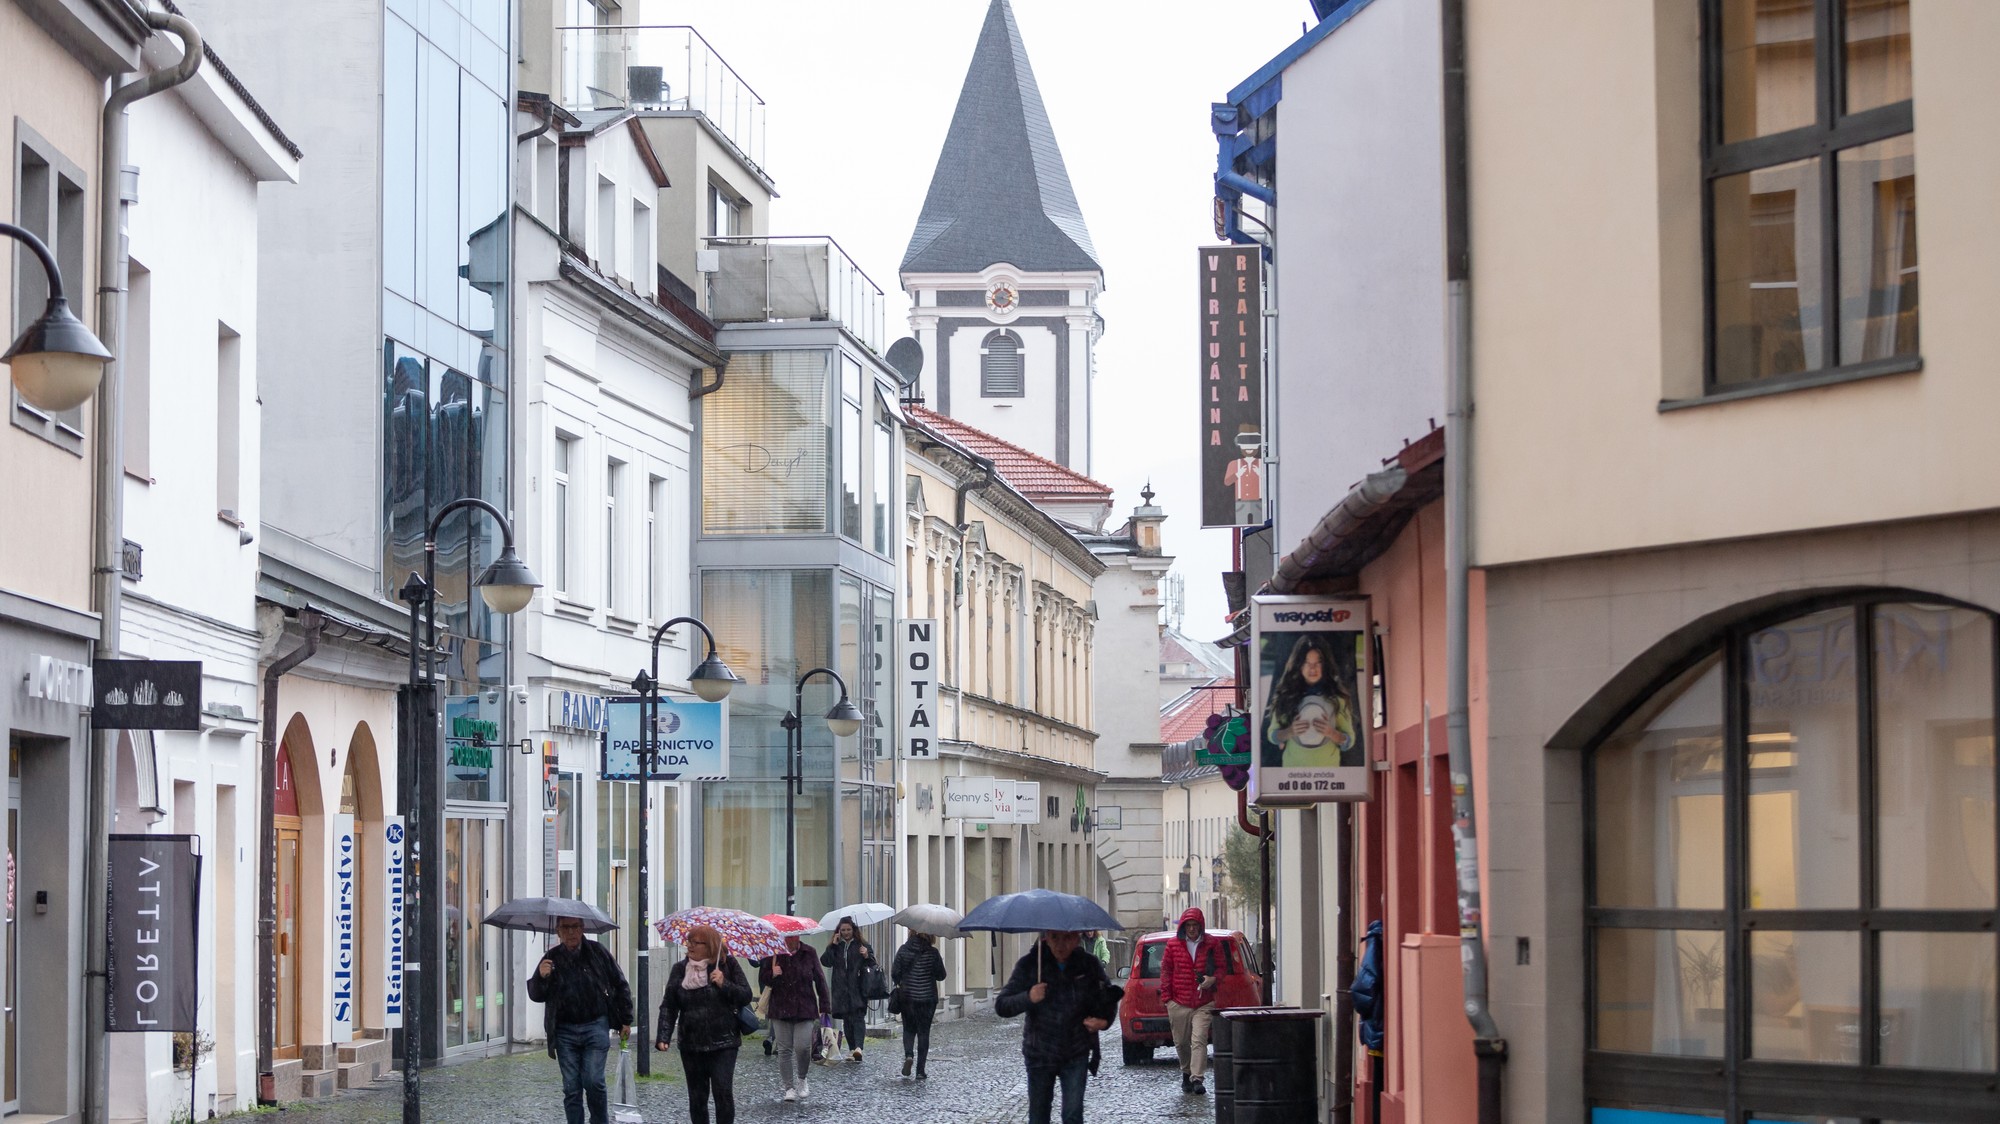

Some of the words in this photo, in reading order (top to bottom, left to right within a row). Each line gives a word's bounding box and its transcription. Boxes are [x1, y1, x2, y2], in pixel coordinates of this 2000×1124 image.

[1208, 255, 1221, 446] VIRTUÁLNA
[1236, 255, 1249, 402] REALITA
[562, 690, 610, 732] RANDA
[613, 739, 714, 751] PAPERNICTVO
[908, 623, 930, 757] NOTÁR
[948, 793, 981, 805] Kenny
[984, 793, 992, 803] S.
[1278, 780, 1290, 791] od
[1292, 780, 1299, 791] 0
[1300, 780, 1312, 791] do
[1314, 780, 1329, 791] 172
[1330, 781, 1345, 791] cm
[335, 834, 352, 1022] Sklenárstvo
[387, 849, 403, 1015] Rámovanie
